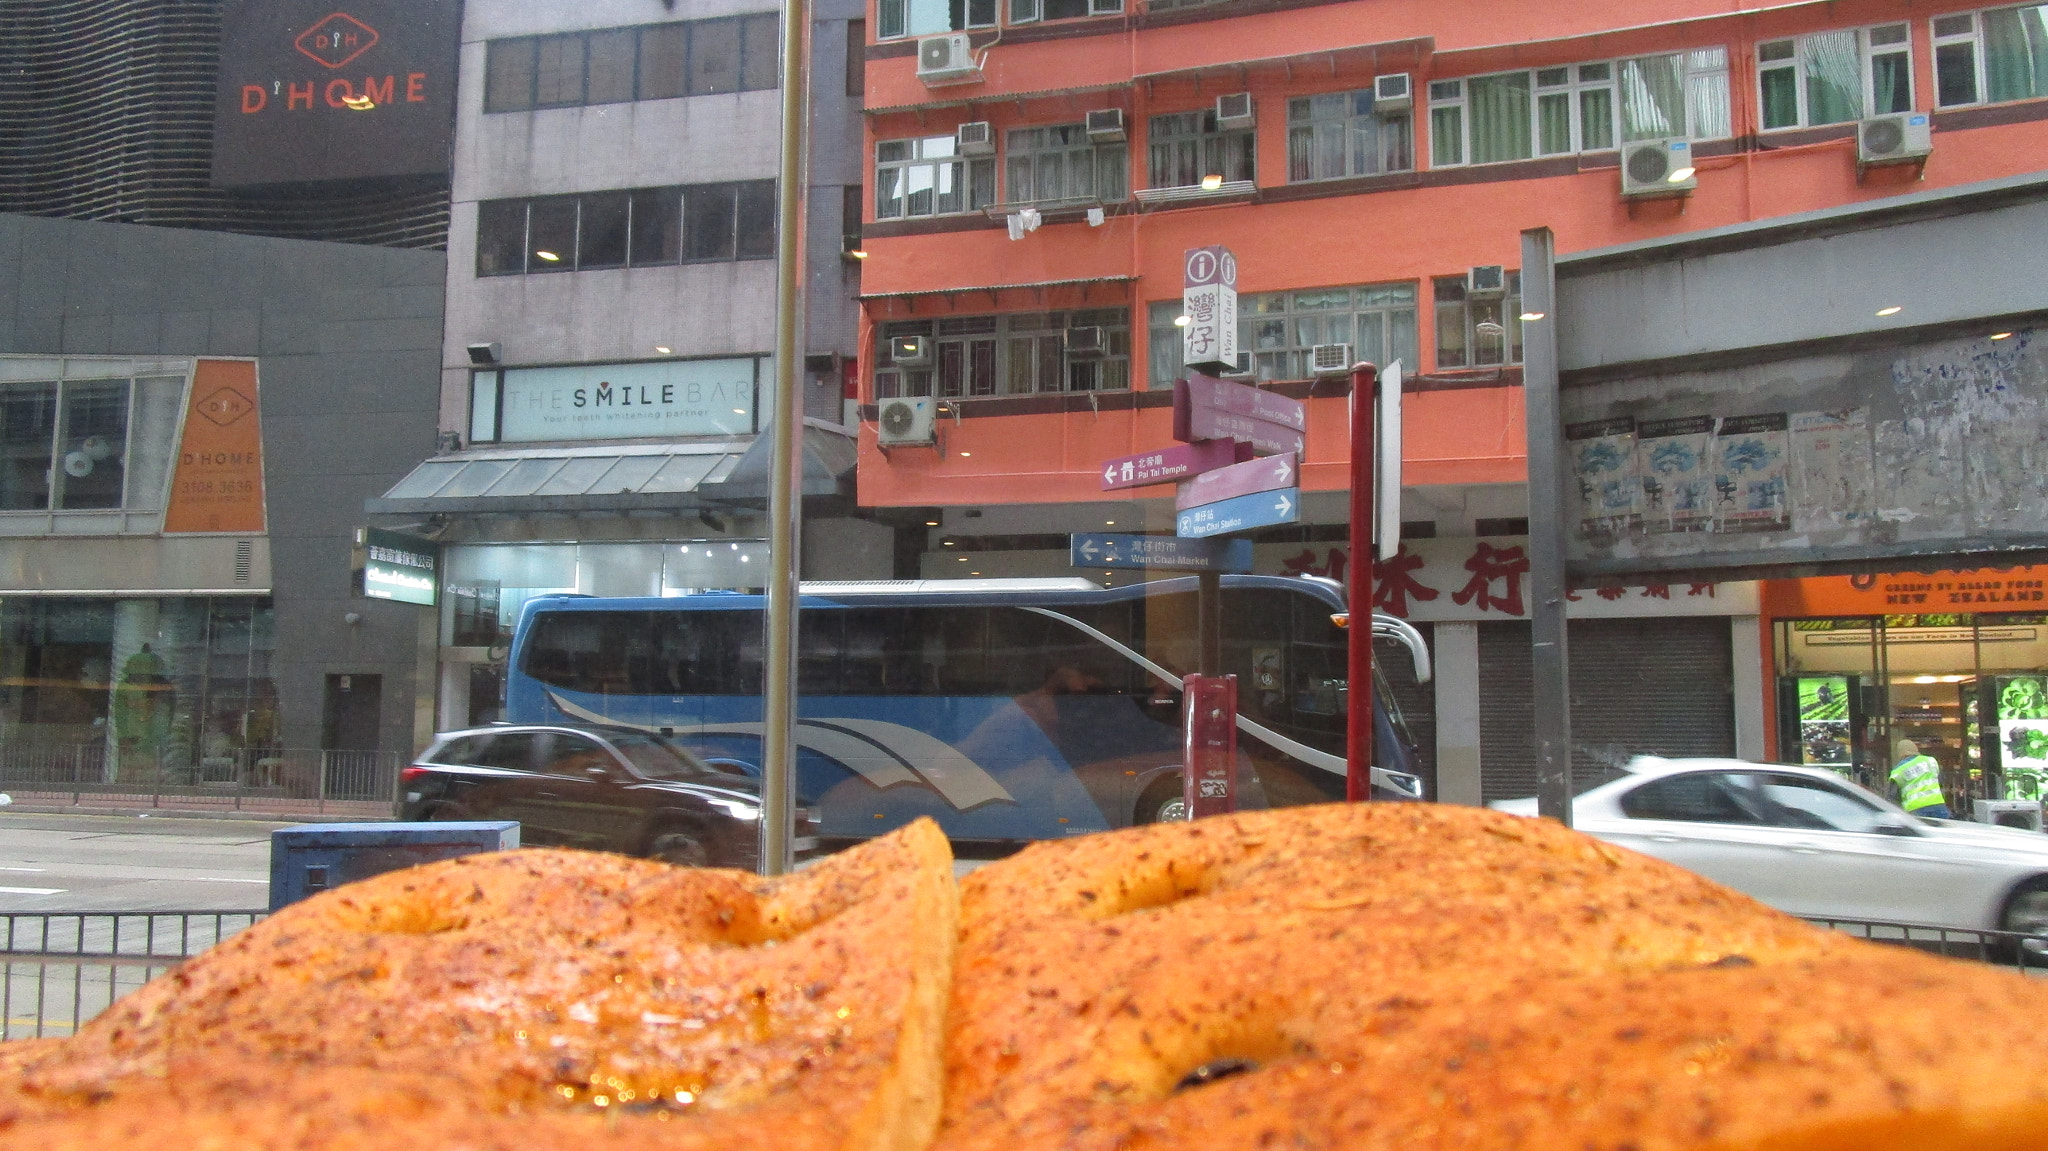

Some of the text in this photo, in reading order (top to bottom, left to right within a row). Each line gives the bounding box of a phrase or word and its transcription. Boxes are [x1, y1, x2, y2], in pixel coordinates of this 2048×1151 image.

[1187, 292, 1216, 355] 灣仔
[1224, 294, 1232, 357] Wan Chai
[510, 380, 750, 410] THE SMILE BAR
[543, 409, 709, 423] Your teeth whitening partner
[1161, 464, 1188, 475] Temple
[1193, 525, 1206, 534] Wan
[1220, 518, 1242, 529] Station
[1131, 554, 1209, 566] Wan Chai Market
[1886, 590, 2044, 605] NEW ZEALAND
